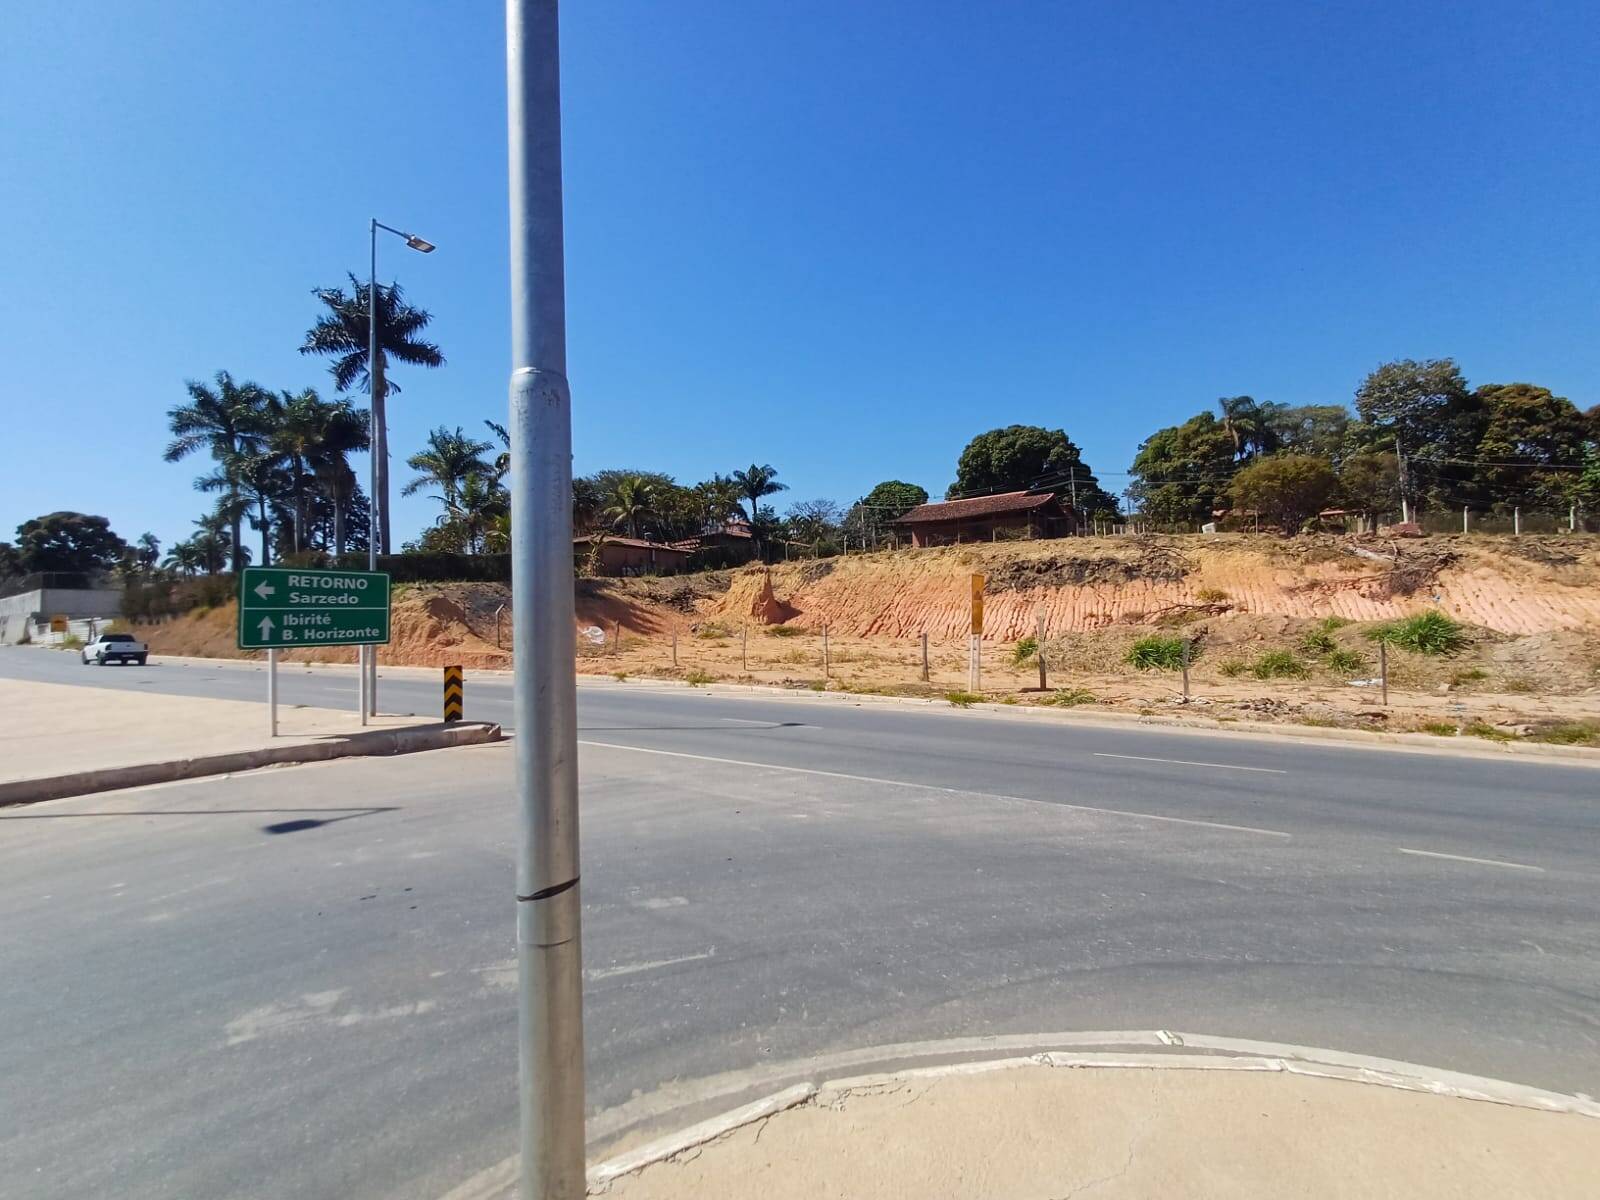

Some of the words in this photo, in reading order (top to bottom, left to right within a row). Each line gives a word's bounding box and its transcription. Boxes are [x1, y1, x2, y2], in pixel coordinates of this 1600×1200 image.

[288, 575, 368, 590] RETORNO
[289, 592, 359, 604] Sarzedo
[283, 613, 332, 626] Ibirité
[282, 629, 298, 641] B.
[304, 627, 380, 640] Horizonte
